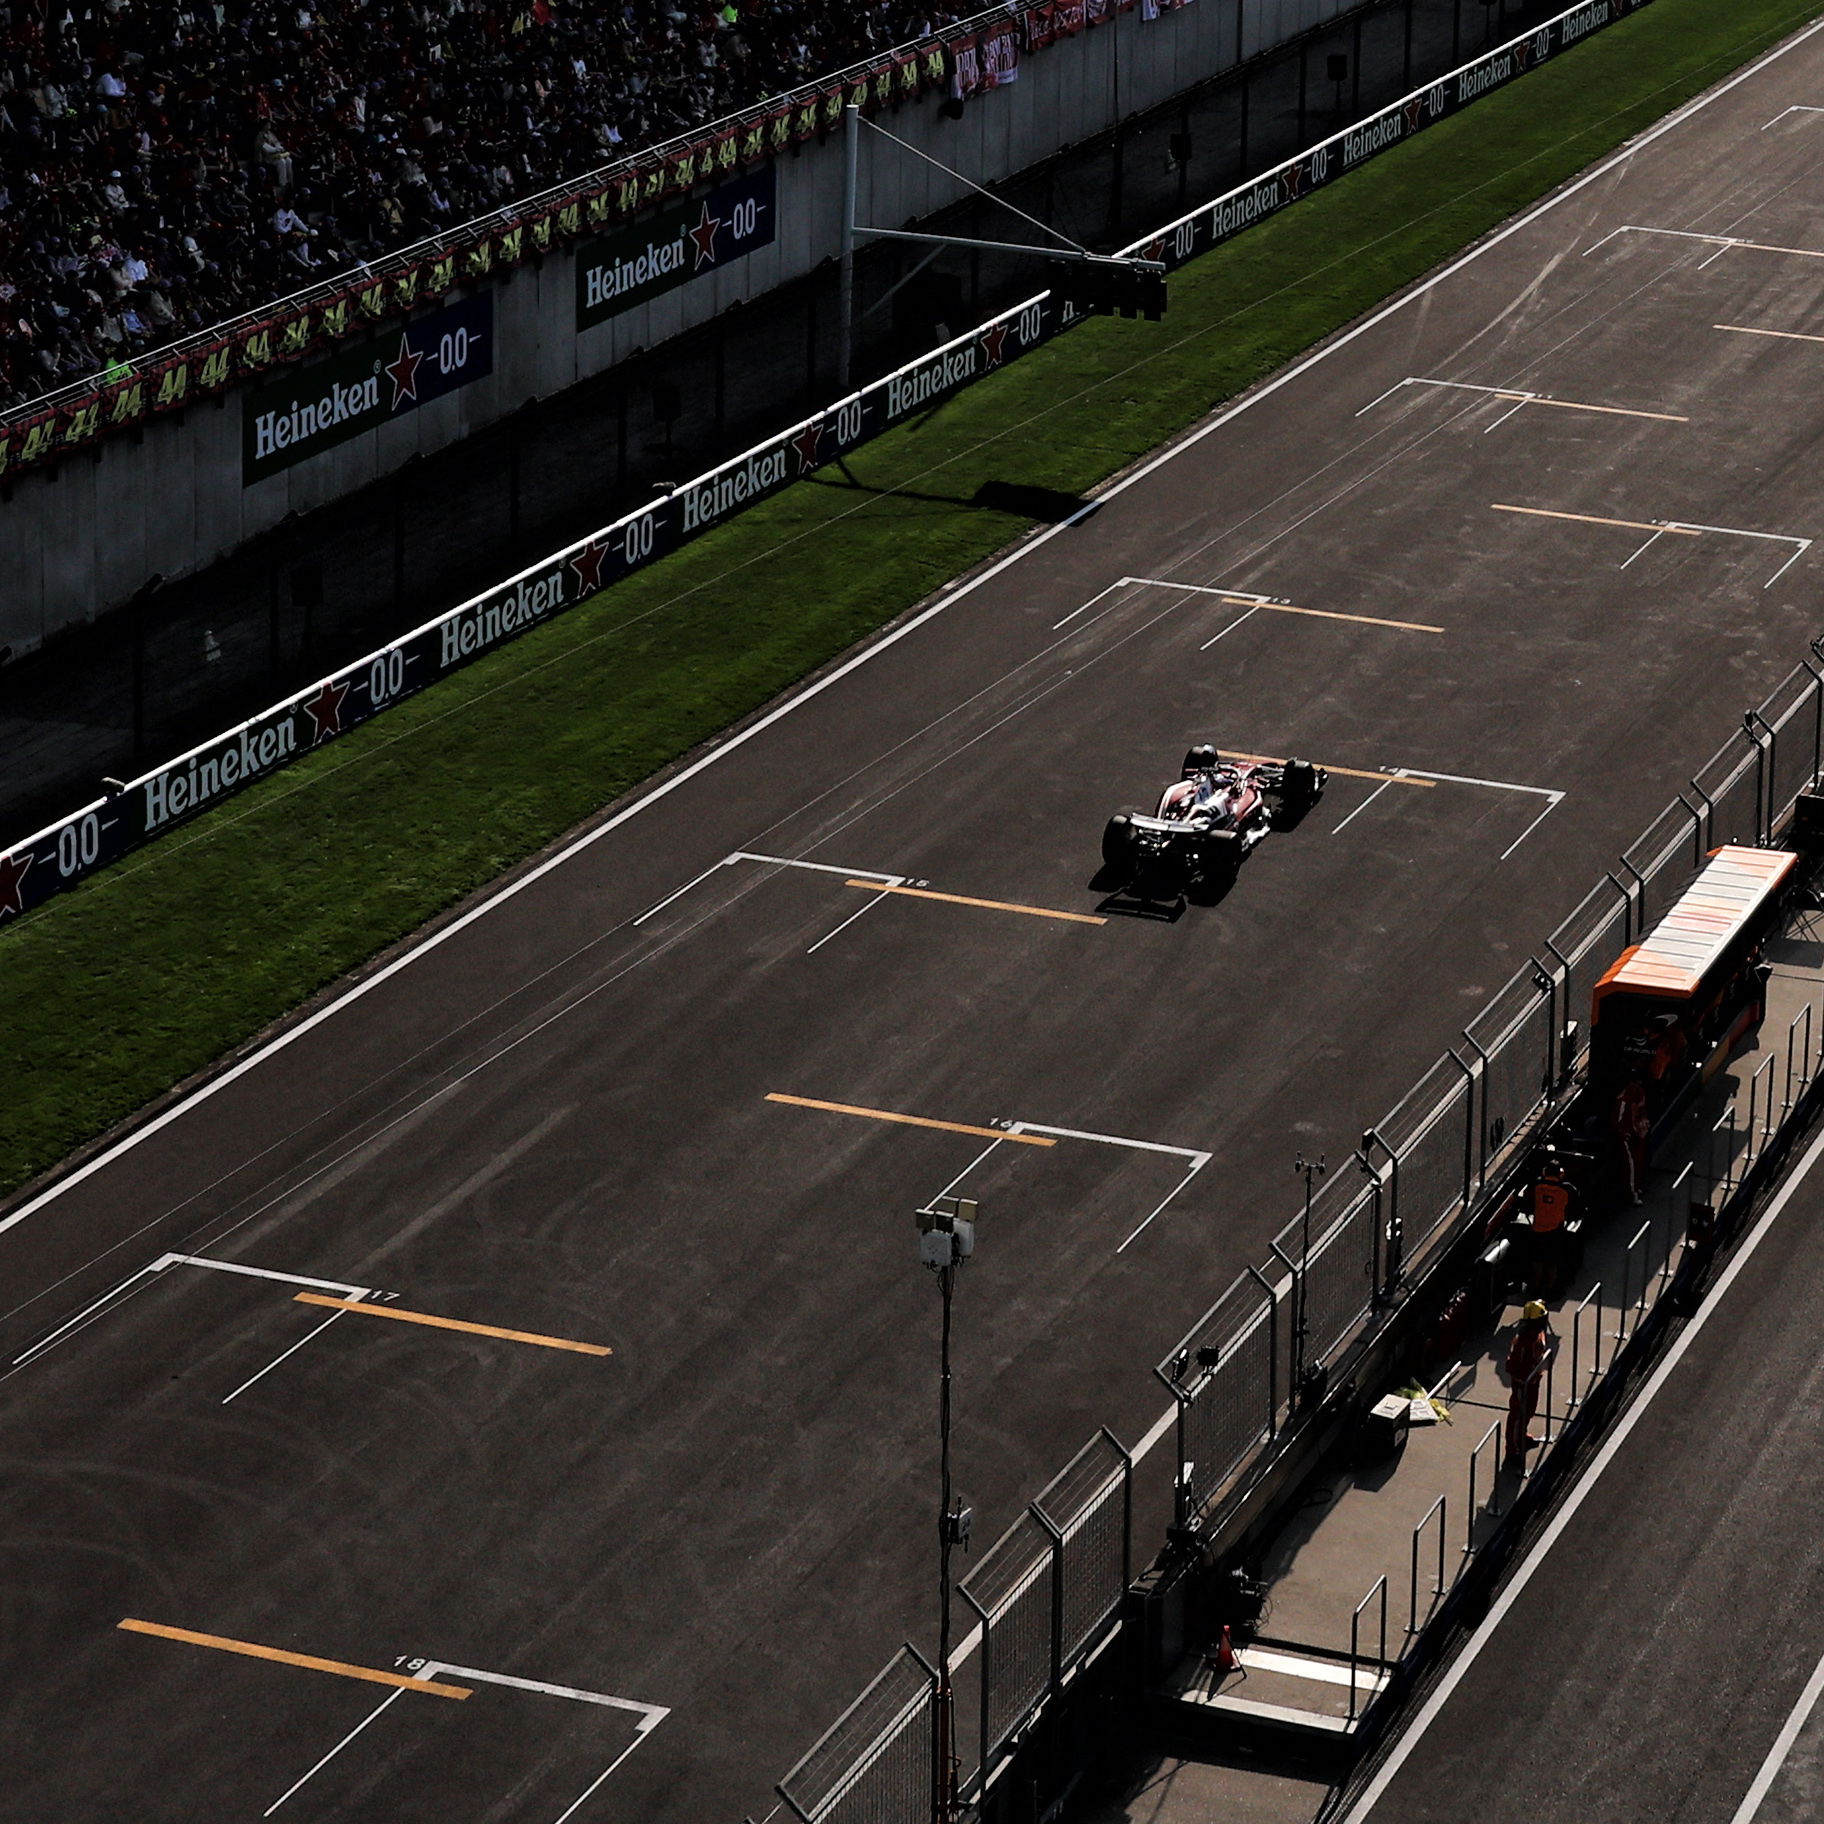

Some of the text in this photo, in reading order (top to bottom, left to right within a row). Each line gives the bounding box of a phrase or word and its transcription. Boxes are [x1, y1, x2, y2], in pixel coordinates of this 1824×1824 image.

[1561, 0, 1608, 45] Heineken
[926, 50, 945, 78] 44
[1458, 54, 1510, 103] Heineken
[718, 137, 737, 167] 44
[1343, 113, 1402, 167] Heineken
[1212, 180, 1279, 240] Heineken
[585, 243, 684, 309] Heineken
[201, 347, 230, 387] 44
[243, 330, 270, 367] 44
[111, 382, 143, 422] 44
[157, 364, 188, 404] 44
[887, 346, 976, 420] Heineken
[65, 401, 100, 442] 44
[254, 374, 379, 460] Heineken
[21, 418, 56, 461] 44
[683, 448, 787, 534] Heineken
[439, 570, 564, 668] Heineken
[145, 716, 297, 832] Heineken
[989, 1117, 1013, 1128] 16
[371, 1290, 400, 1302] 17
[393, 1655, 426, 1671] 18
